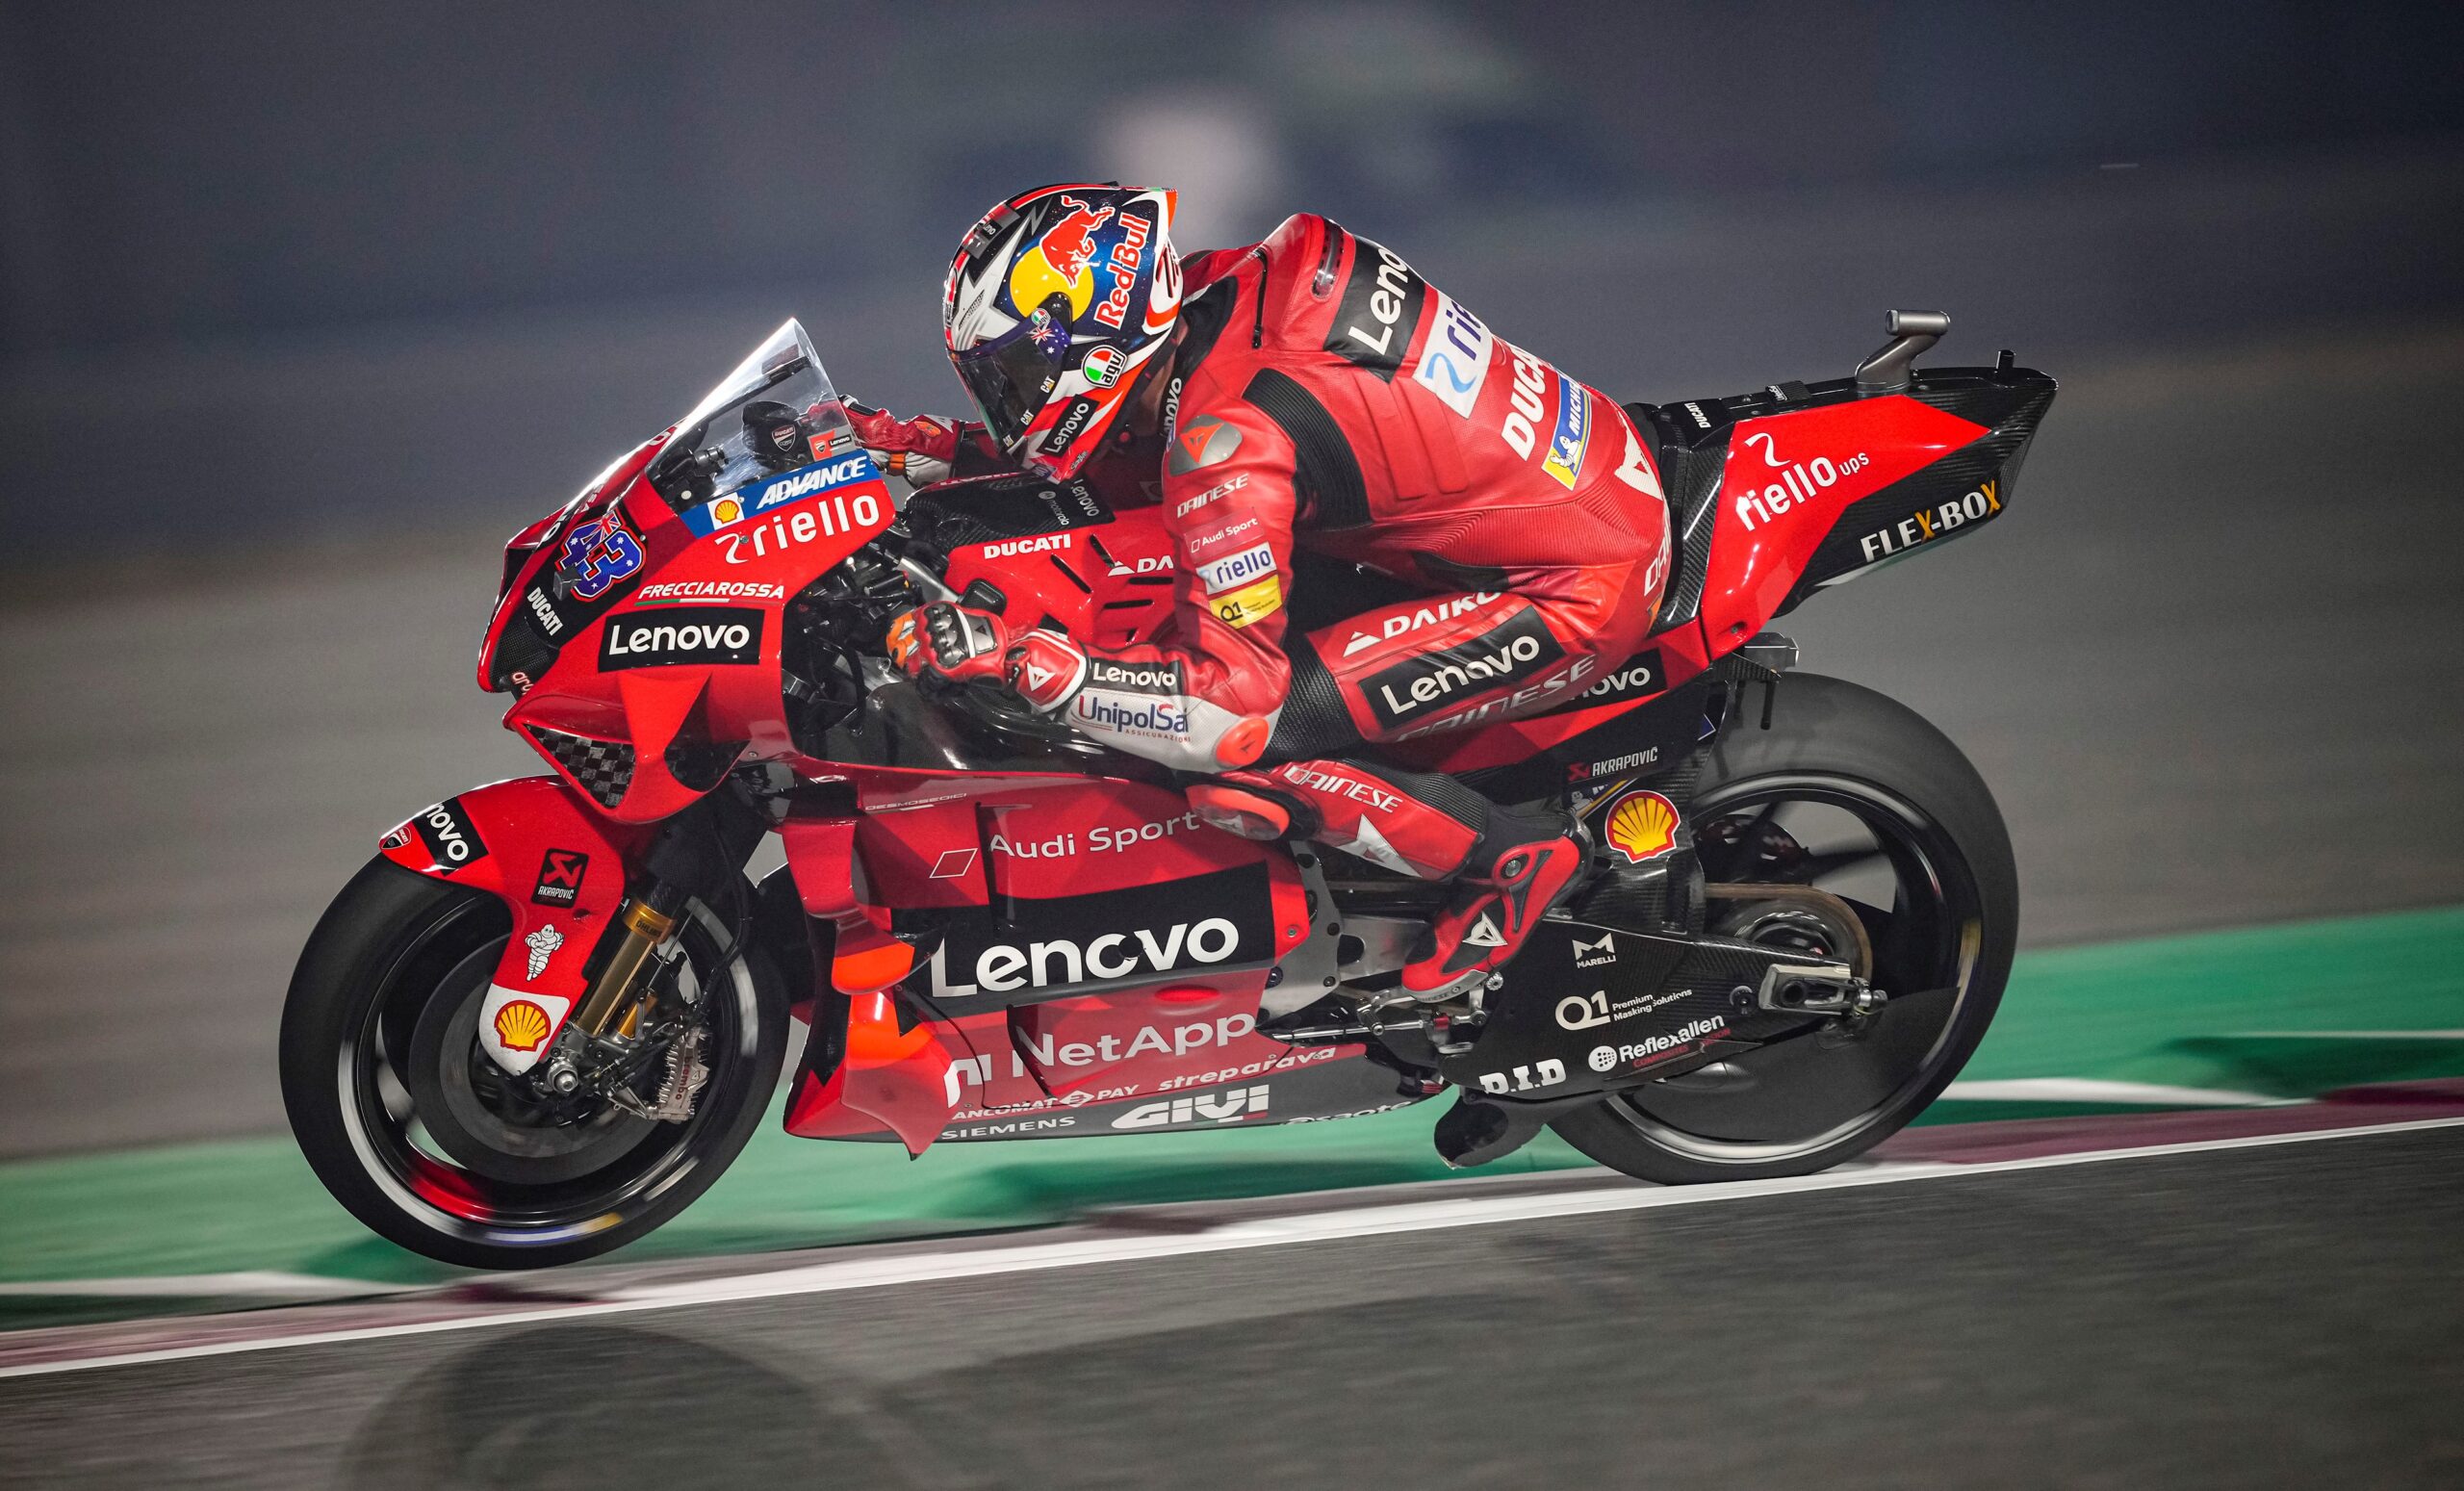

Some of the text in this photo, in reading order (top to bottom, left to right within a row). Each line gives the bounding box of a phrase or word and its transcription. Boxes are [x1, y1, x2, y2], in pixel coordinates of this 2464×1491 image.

[1040, 375, 1056, 394] CAT
[1101, 353, 1123, 384] agv
[1020, 408, 1035, 425] CAT
[1163, 377, 1182, 437] enovo
[1684, 401, 1711, 428] DUCATI
[829, 435, 851, 447] Lenovo
[1044, 402, 1090, 453] Lenovo
[757, 456, 867, 509] ADVANCE
[1177, 474, 1249, 519] DAINESE
[1735, 452, 1870, 531] riello ups
[753, 495, 880, 557] riello
[1202, 518, 1259, 546] Audi Sport
[1861, 479, 2001, 563] FLEX-BOX
[555, 510, 647, 602] 43
[984, 533, 1071, 559] DUCATI
[1217, 550, 1271, 583] riello
[638, 581, 784, 600] FRECCIAROSSA
[526, 586, 563, 636] DUCATI
[1220, 602, 1244, 622] Q1
[608, 623, 751, 656] Lenovo
[1092, 662, 1176, 687] Lenovo
[1381, 635, 1539, 714] Lenovo
[1582, 667, 1651, 698] ovo
[865, 792, 967, 810] DESMOSEDICI
[1283, 765, 1403, 813] DAINESE
[989, 811, 1200, 859] Audi Sport
[931, 917, 1239, 997] Lenovo
[1577, 955, 1617, 968] MARELLI
[1555, 990, 1611, 1031] Q1
[1612, 992, 1654, 1012] Premium
[1613, 1004, 1653, 1022] Masking
[1012, 1013, 1255, 1078] NetApp
[1619, 1015, 1725, 1063] Reflexallen
[1158, 1047, 1336, 1092] streparava
[952, 1084, 1140, 1120] ANCOMAT PAY
[1112, 1084, 1270, 1129] GIVI
[941, 1116, 1076, 1140] SIEMENS
